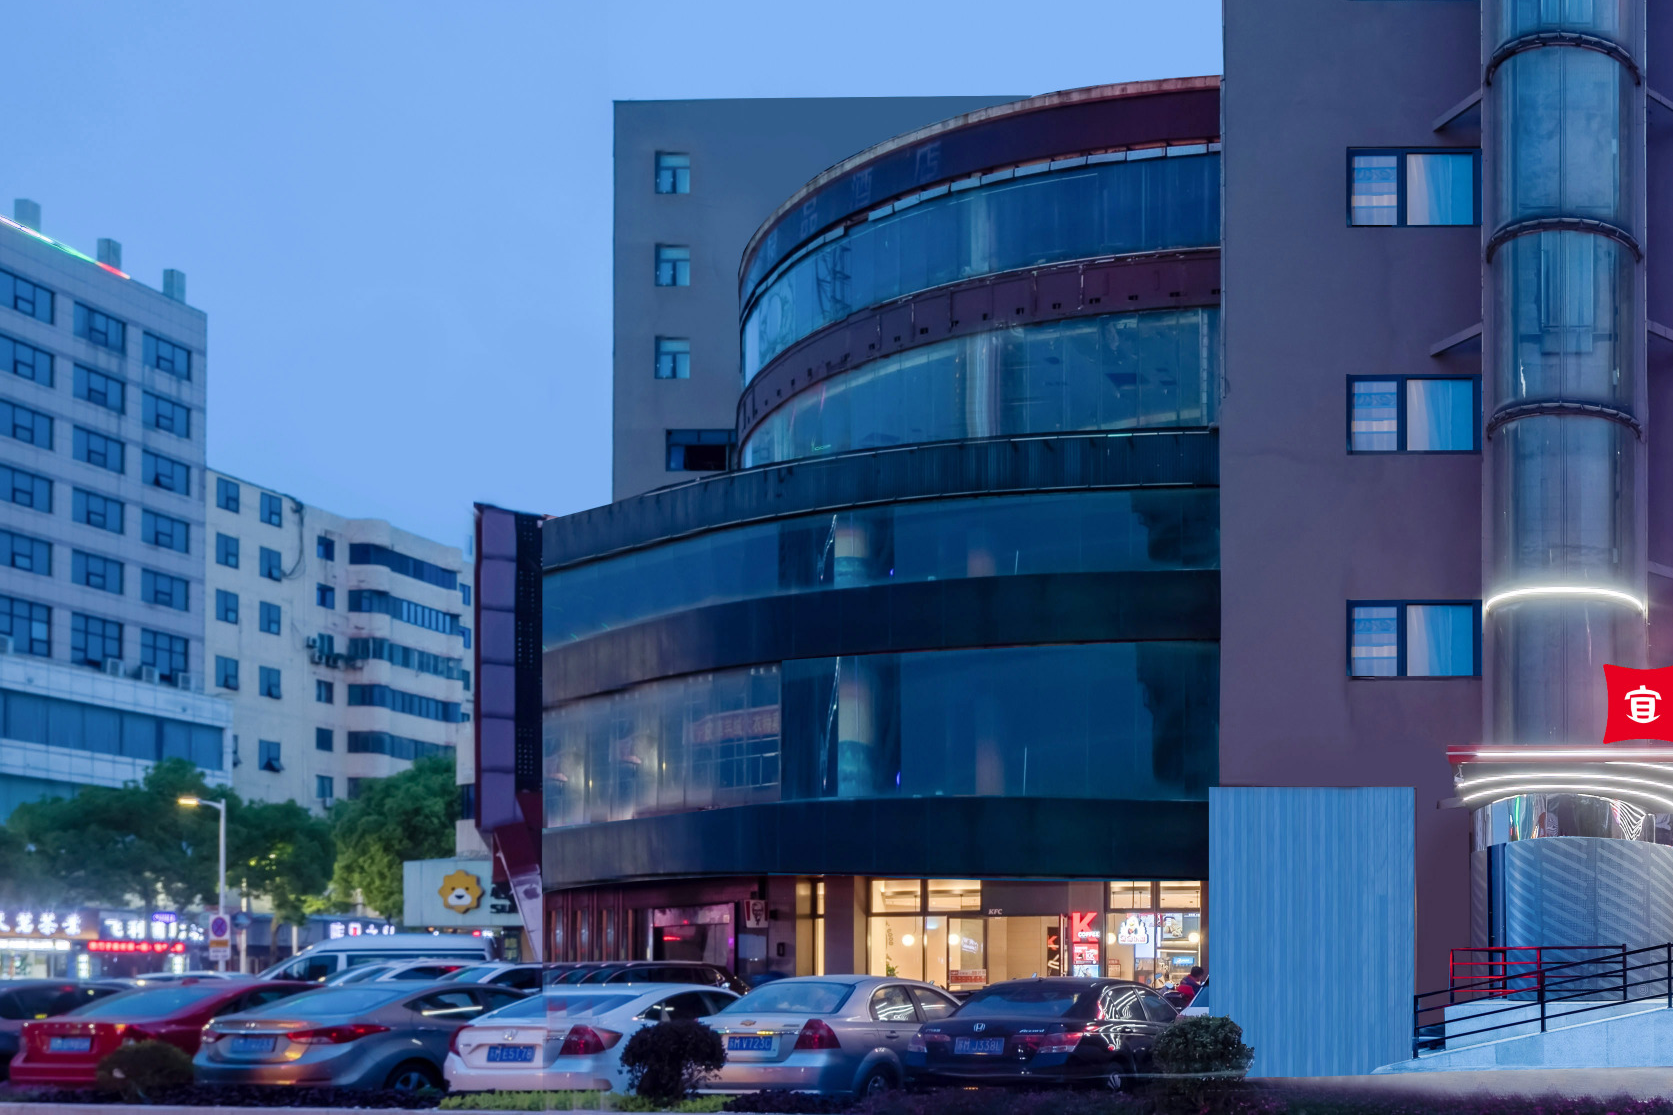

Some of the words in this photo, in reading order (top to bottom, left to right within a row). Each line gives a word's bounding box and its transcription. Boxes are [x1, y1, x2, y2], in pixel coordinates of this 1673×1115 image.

[1624, 684, 1662, 724] 宜
[1072, 911, 1098, 943] K
[1077, 930, 1101, 938] COFFEE
